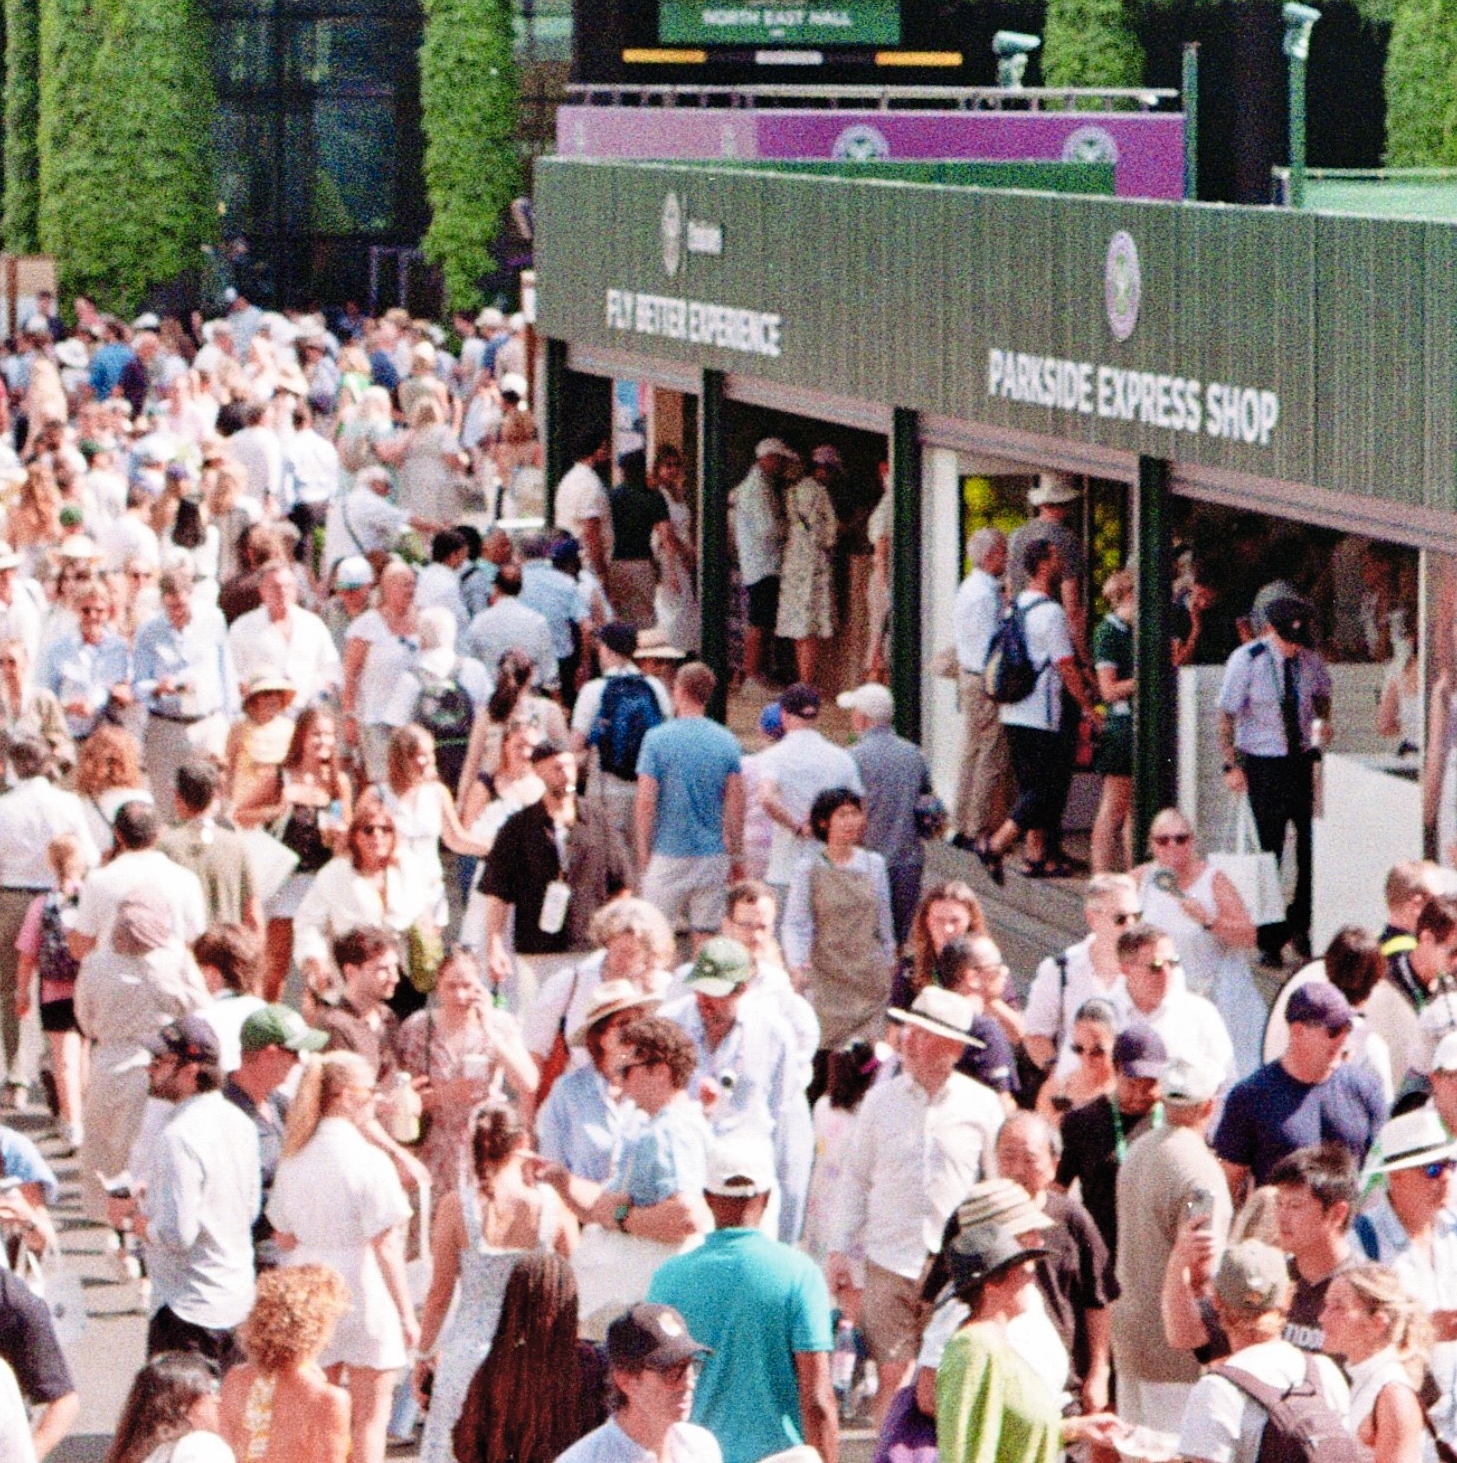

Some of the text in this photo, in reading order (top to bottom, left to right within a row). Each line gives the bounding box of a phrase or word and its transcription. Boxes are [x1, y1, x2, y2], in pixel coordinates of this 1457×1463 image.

[762, 9, 805, 26] EAST
[988, 348, 1281, 445] PARKSIDE EXPRESS SHOP
